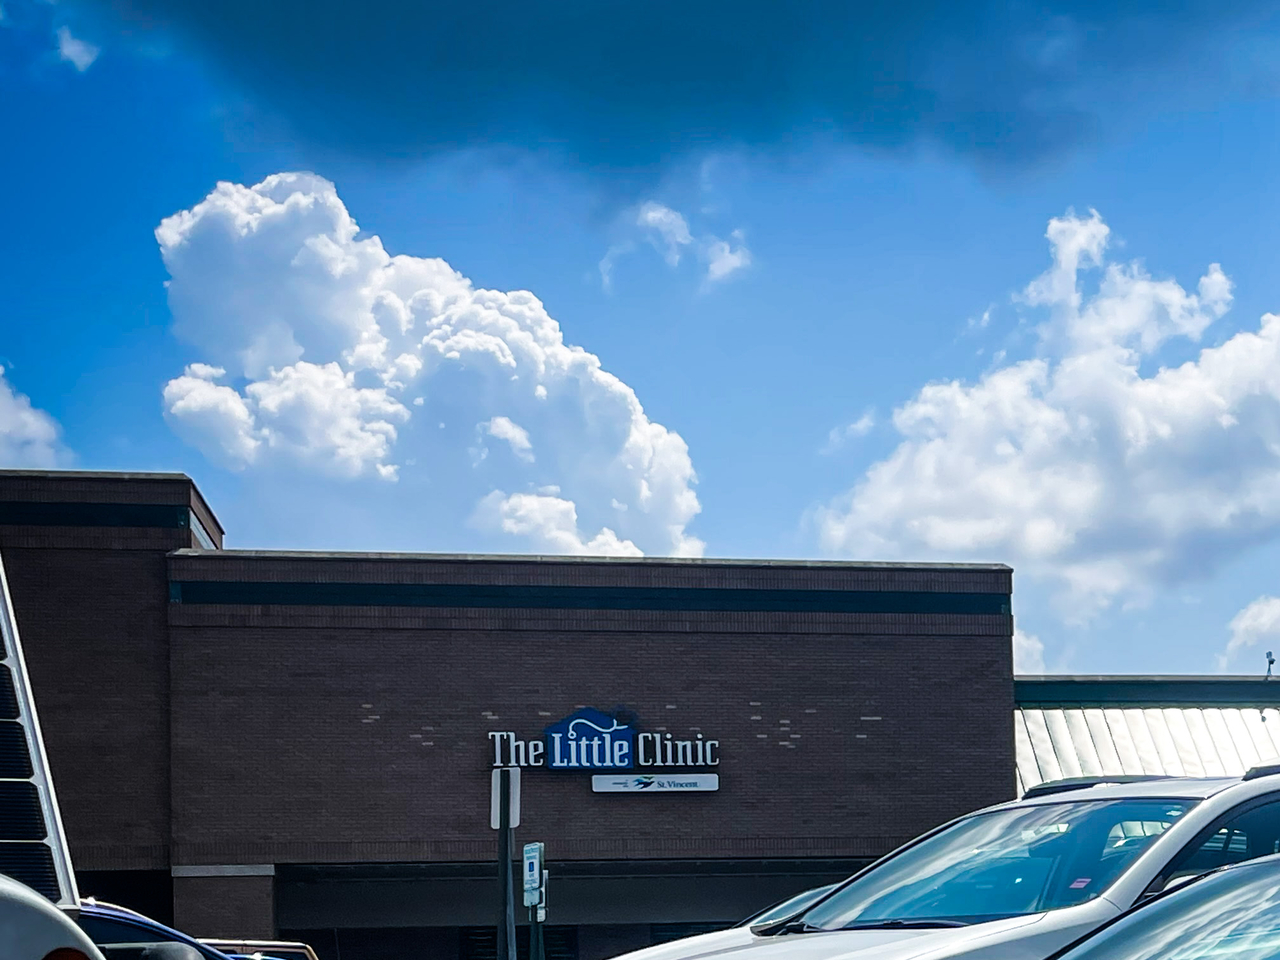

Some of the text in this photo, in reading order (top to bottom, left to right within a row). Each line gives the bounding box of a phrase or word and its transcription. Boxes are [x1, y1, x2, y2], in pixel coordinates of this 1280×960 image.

[488, 731, 720, 767] The Little Clinic
[668, 780, 699, 788] Vincent
